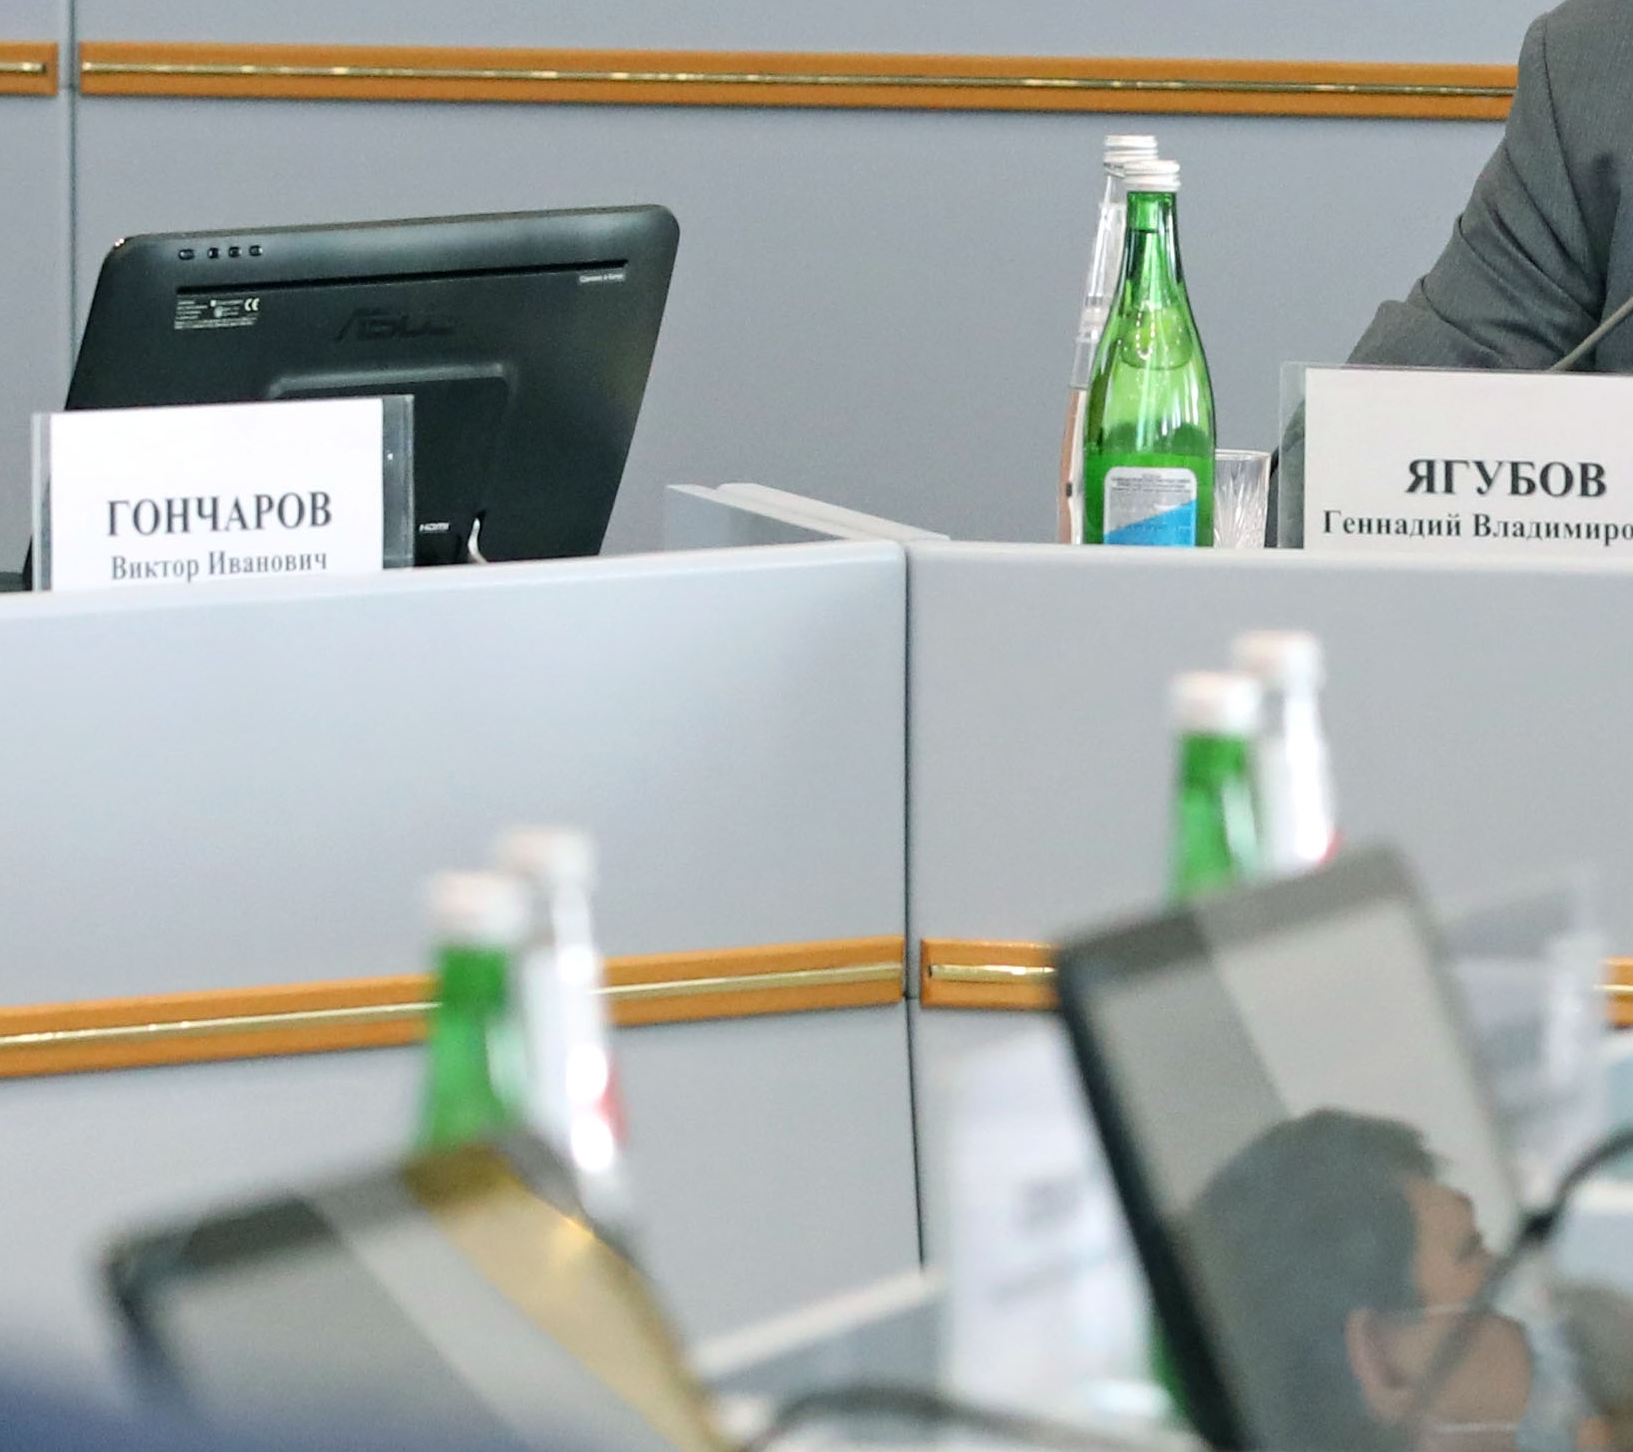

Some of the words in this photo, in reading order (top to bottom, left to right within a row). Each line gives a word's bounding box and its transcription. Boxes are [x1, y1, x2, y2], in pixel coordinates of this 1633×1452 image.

[244, 297, 260, 312] CE
[1404, 457, 1608, 498] ЯГУБОВ
[107, 491, 332, 536] ГОНЧАРОВ
[419, 522, 450, 532] HDMI
[1322, 509, 1462, 539] Геннадий
[111, 555, 200, 583] Виктор
[207, 550, 328, 575] Иванович
